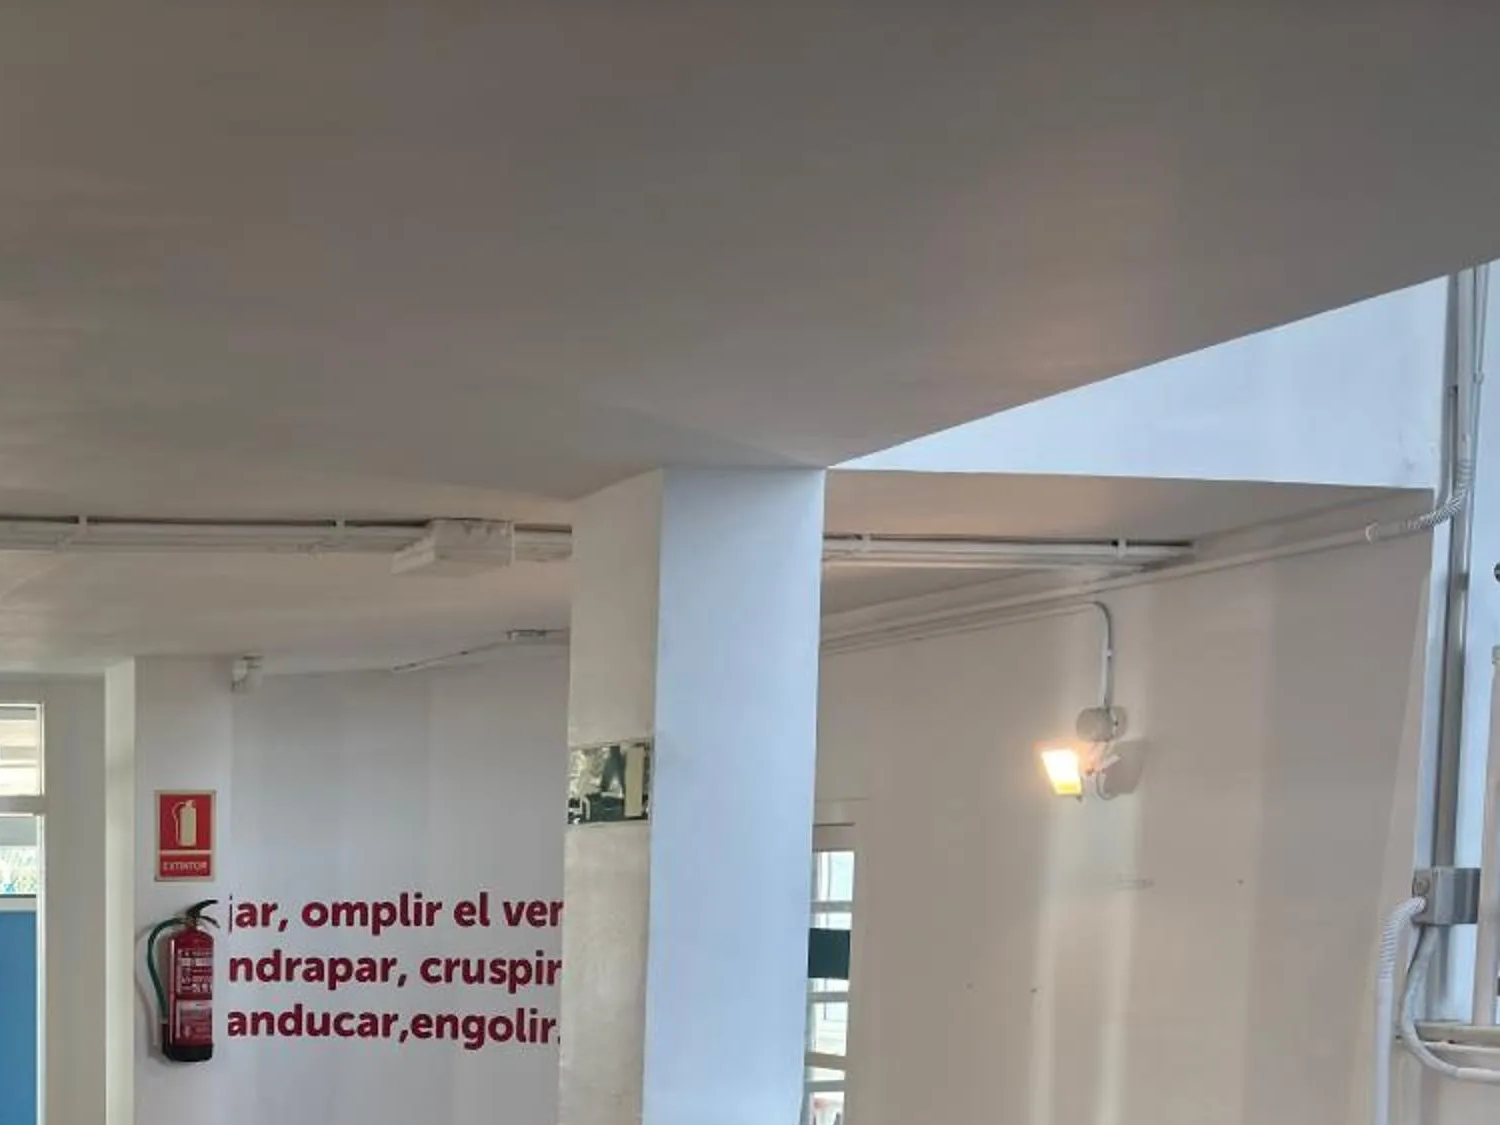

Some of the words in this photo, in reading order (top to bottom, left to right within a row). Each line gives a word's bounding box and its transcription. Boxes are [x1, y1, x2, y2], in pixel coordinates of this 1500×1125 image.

[301, 891, 443, 938] omplir
[453, 891, 491, 928] el
[229, 948, 407, 991] ndrapar,
[419, 949, 563, 995] cruspir
